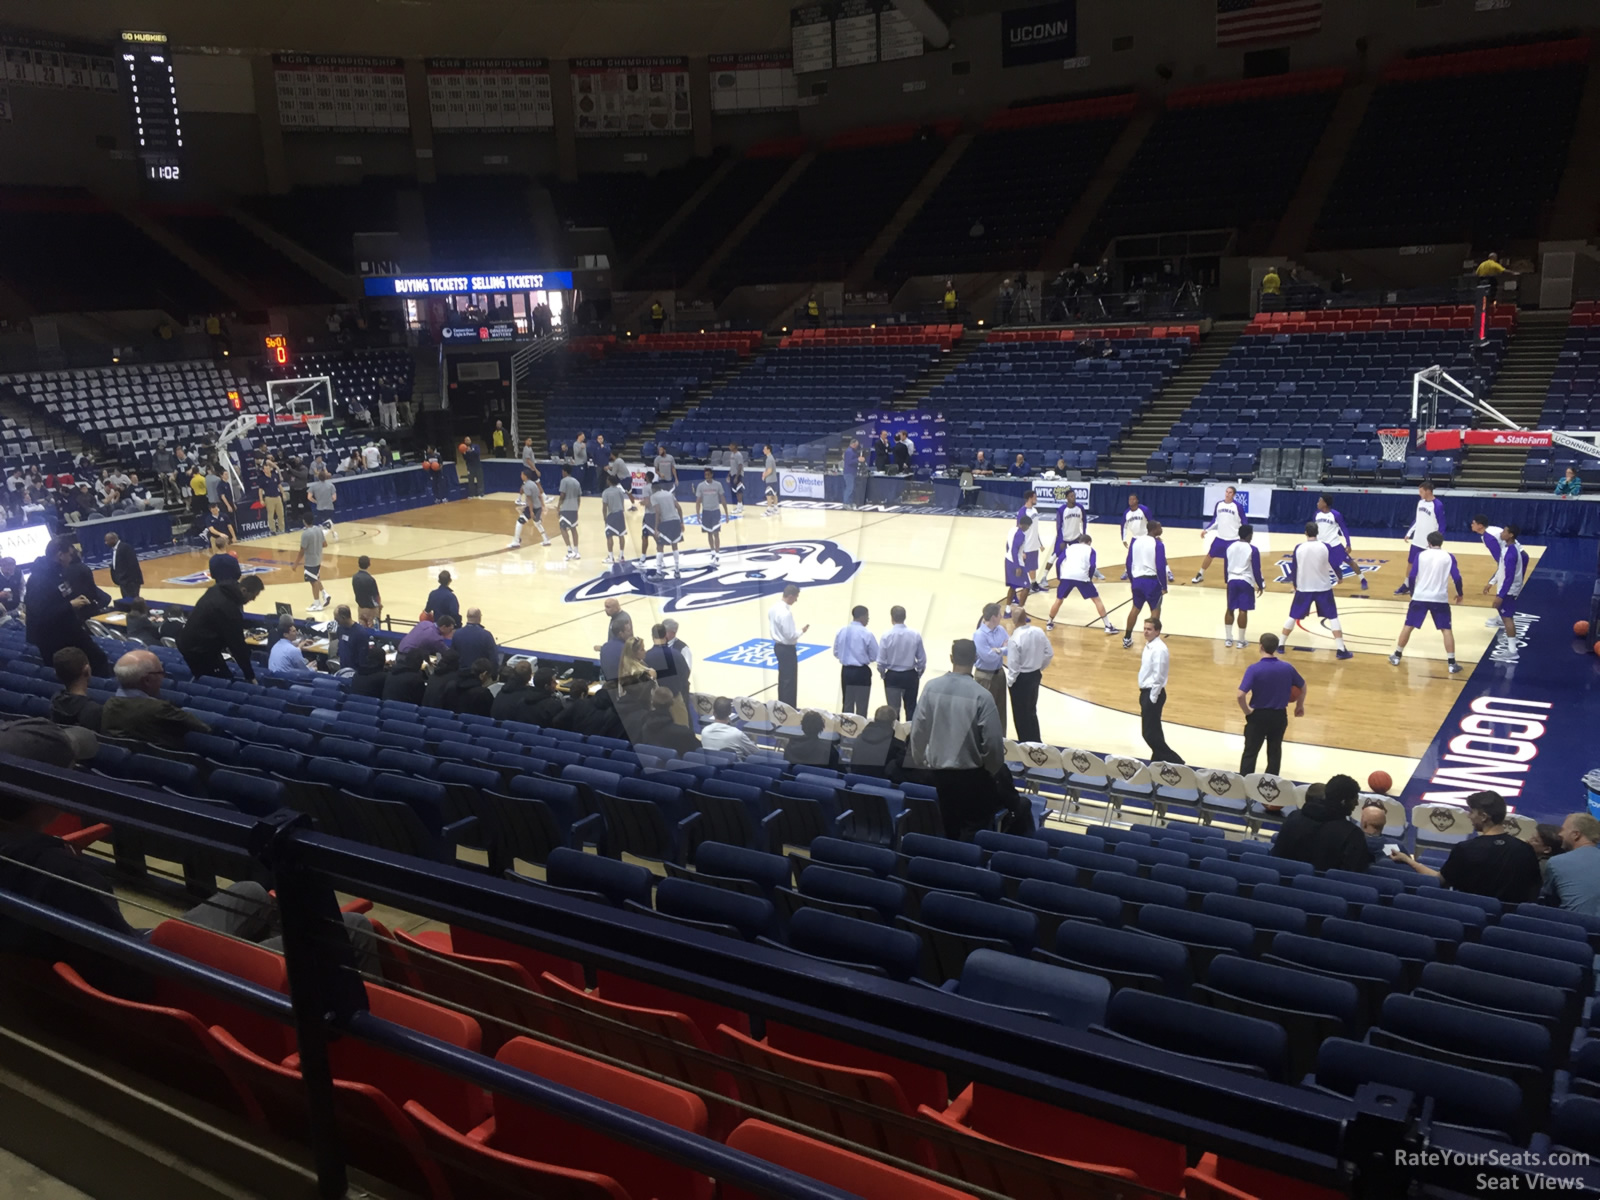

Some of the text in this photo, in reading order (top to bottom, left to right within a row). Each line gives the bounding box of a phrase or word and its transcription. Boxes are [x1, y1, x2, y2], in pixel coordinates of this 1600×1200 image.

[1010, 19, 1068, 42] UCONN
[121, 33, 167, 43] GO HUSKIES
[315, 57, 397, 66] CHAMPIONSHIP
[576, 58, 682, 67] NCAA CHAMPIONSHIP
[99, 71, 111, 87] 14
[395, 274, 543, 293] BUYING TICKETS? SELLING TICKETS?
[276, 347, 286, 363] 0
[1506, 435, 1548, 445] State Farm
[797, 477, 823, 486] Webster
[1035, 488, 1053, 497] WTIC
[1420, 696, 1554, 813] UCONN
